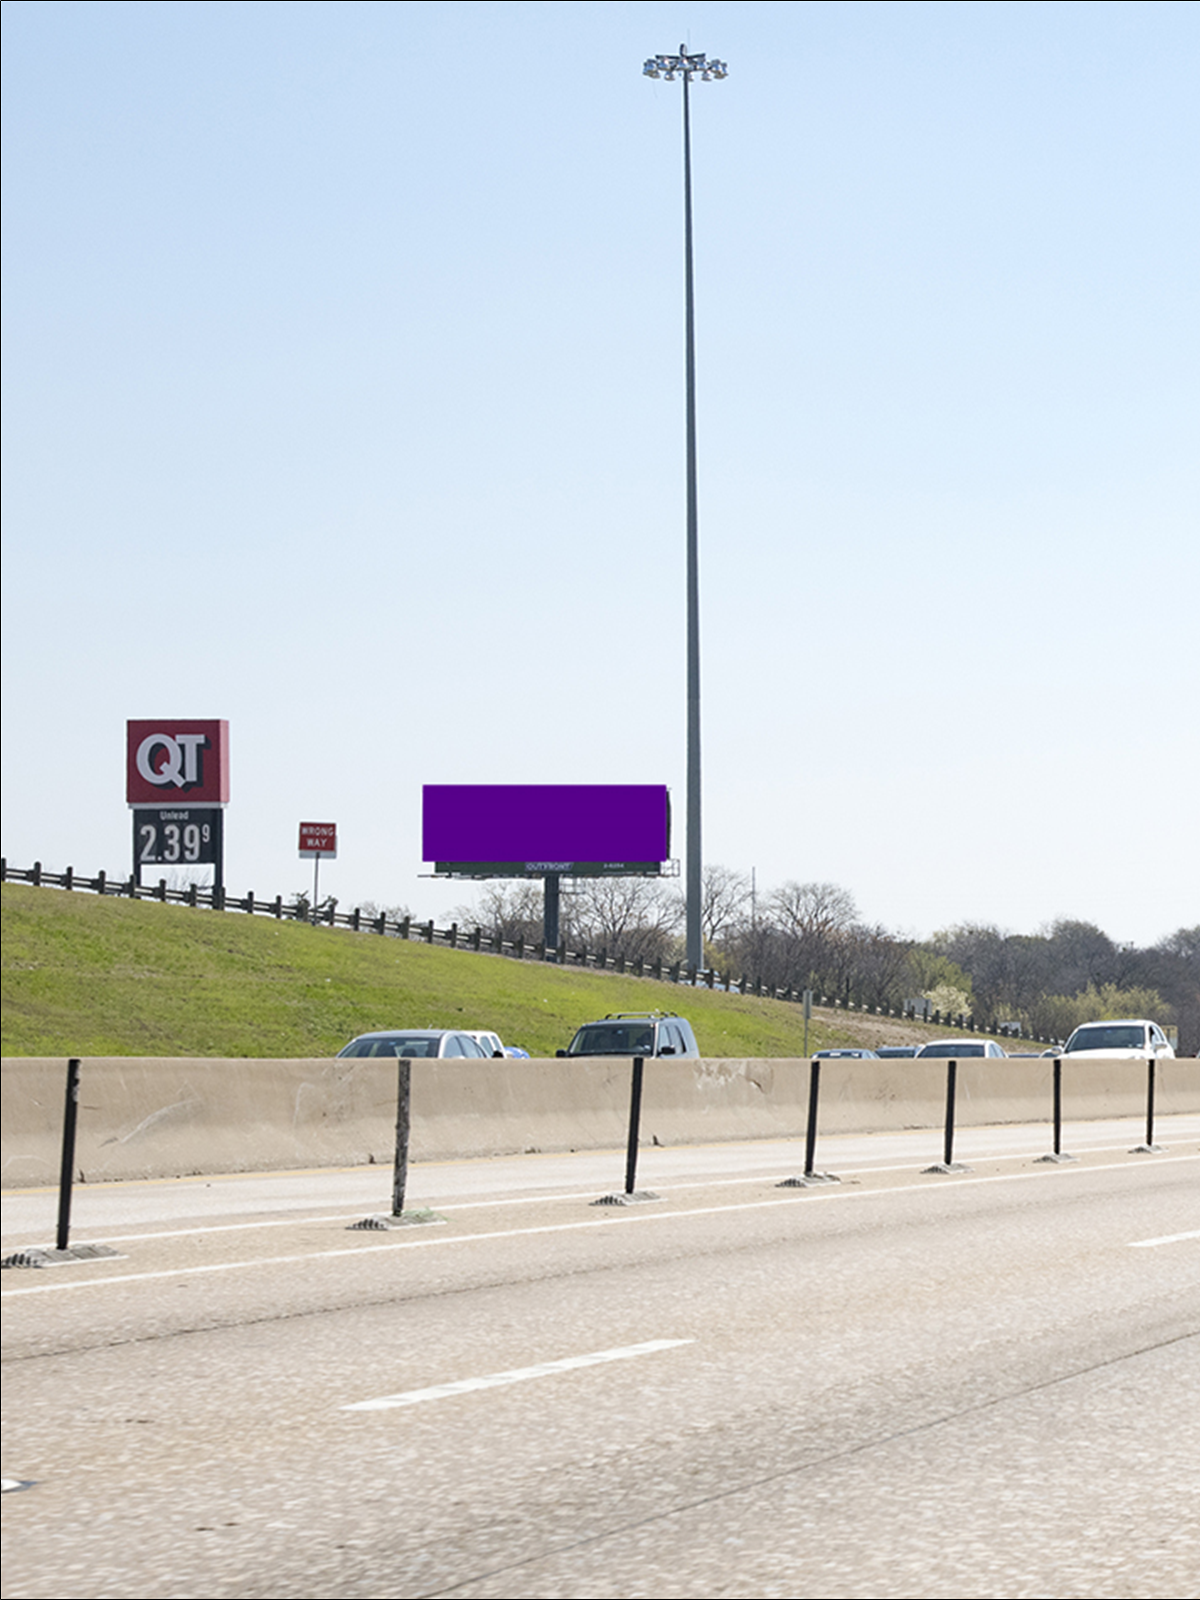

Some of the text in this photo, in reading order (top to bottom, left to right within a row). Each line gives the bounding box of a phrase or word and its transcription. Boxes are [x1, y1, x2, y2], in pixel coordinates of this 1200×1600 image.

[136, 733, 206, 788] QT
[160, 810, 189, 820] Unlead
[301, 827, 334, 836] WRONG
[306, 838, 328, 847] WAY
